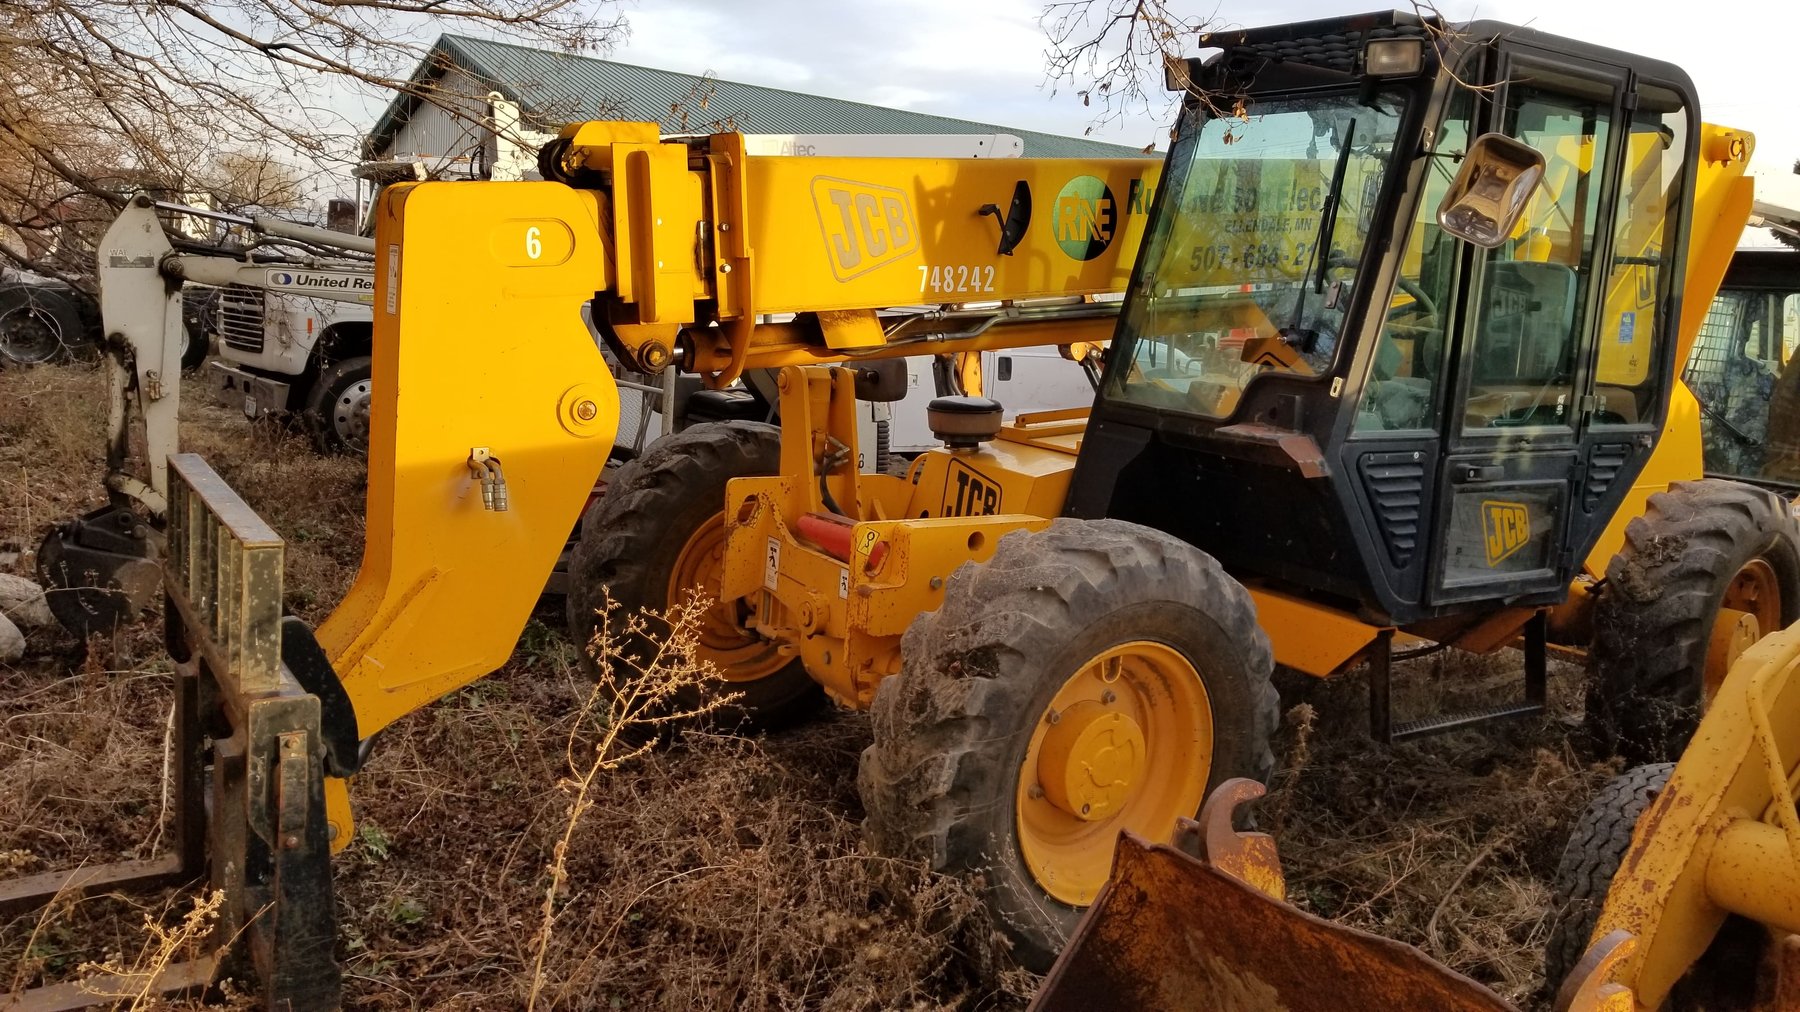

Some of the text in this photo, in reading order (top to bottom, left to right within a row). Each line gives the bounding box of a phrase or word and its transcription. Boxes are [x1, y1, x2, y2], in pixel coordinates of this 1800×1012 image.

[781, 141, 816, 157] Altec
[828, 188, 910, 270] JCB
[1058, 193, 1111, 243] RNE
[1295, 217, 1313, 231] MN
[525, 225, 542, 260] 6
[295, 274, 348, 288] United
[917, 265, 995, 293] 748242
[945, 469, 998, 518] JCB
[1489, 507, 1528, 559] JCB
